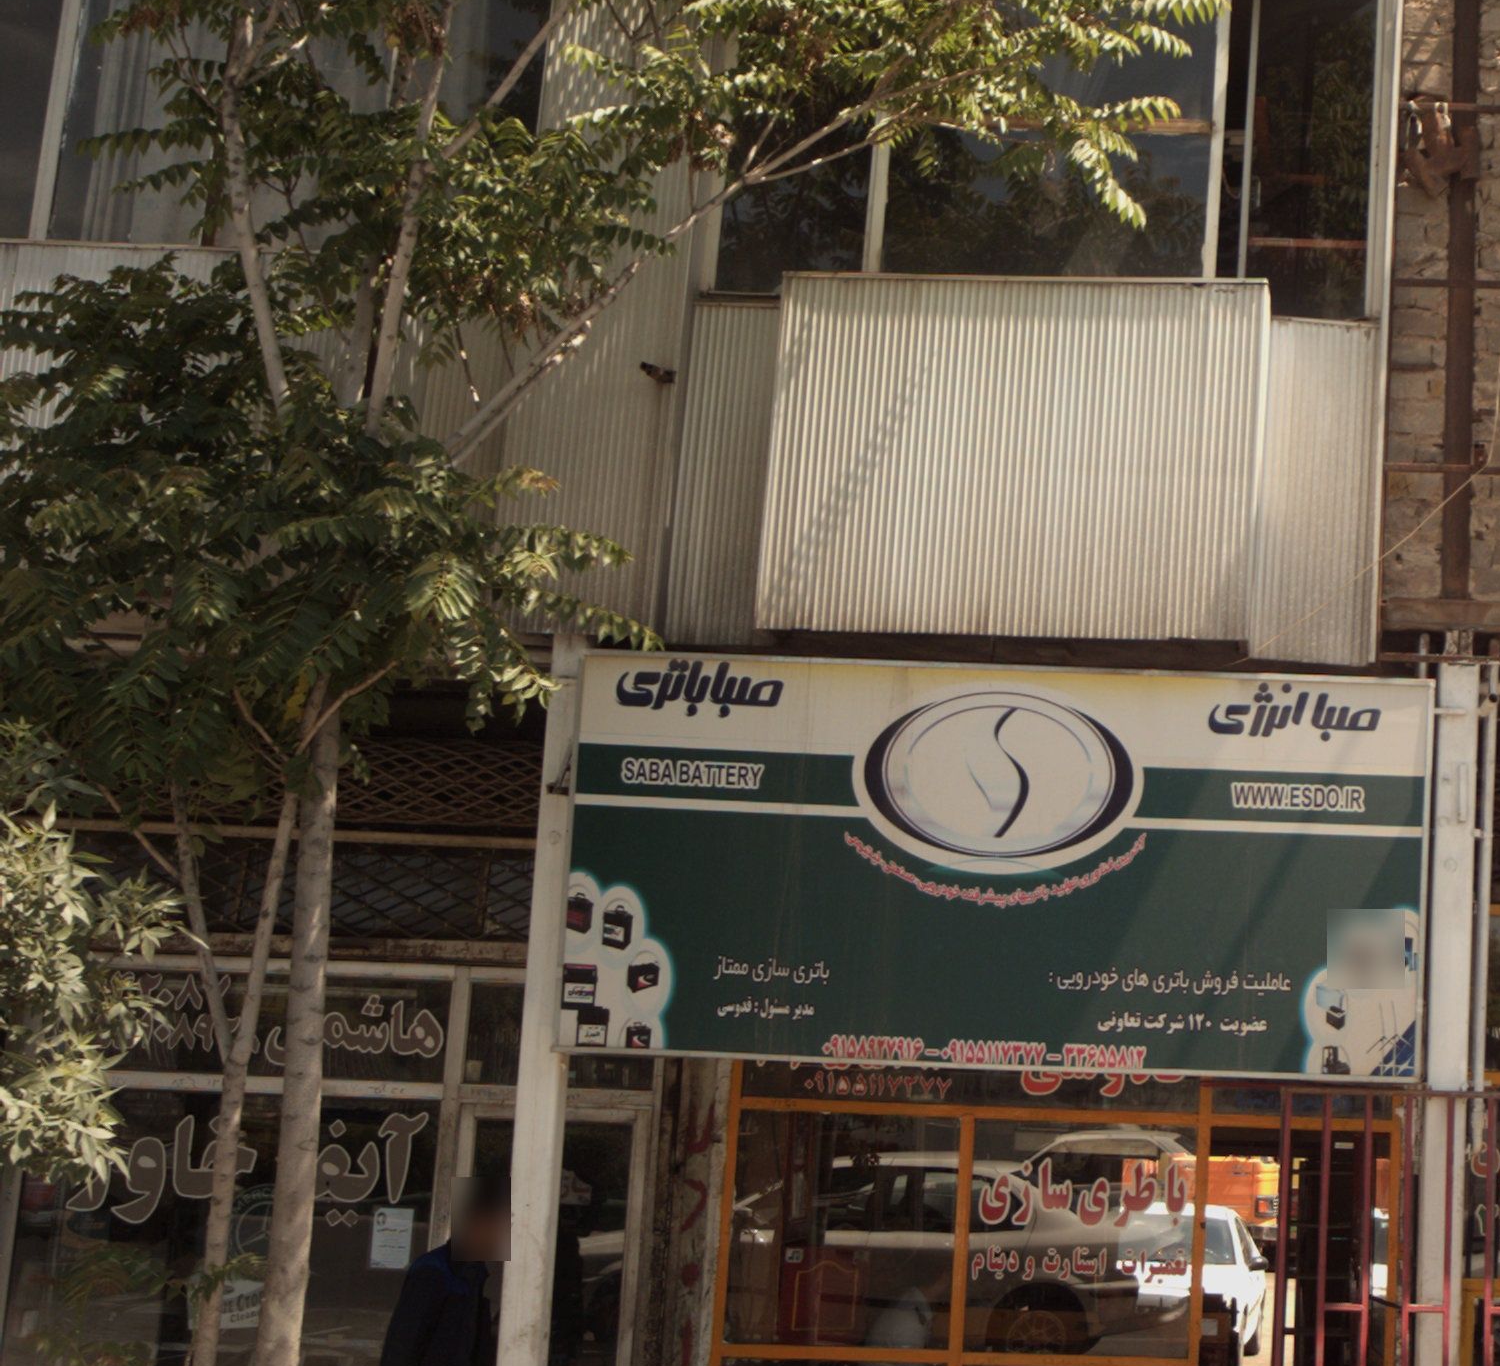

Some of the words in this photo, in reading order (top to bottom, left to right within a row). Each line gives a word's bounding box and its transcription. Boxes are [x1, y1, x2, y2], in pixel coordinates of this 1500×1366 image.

[1208, 682, 1310, 738] انرژی
[1310, 691, 1382, 742] صبا
[621, 757, 675, 784] SABA
[677, 759, 765, 789] BATTERY
[1231, 782, 1365, 812] WWW.ESDO.IR
[713, 955, 749, 980] ممتاز
[752, 957, 790, 983] سازی
[793, 960, 830, 985] باتری
[1121, 968, 1149, 992] های
[1152, 969, 1190, 995] باتری
[1193, 970, 1239, 995] فروش
[1243, 970, 1292, 997] عاملیت
[717, 996, 752, 1017] قدوسی
[1096, 1009, 1141, 1033] تعاونی
[1143, 1011, 1185, 1034] شرکت
[1219, 1013, 1268, 1036] عضویت
[979, 1156, 1073, 1226] سازی
[1077, 1161, 1188, 1227] باطری
[971, 1244, 1020, 1282] دینام
[1022, 1254, 1036, 1282] و
[1042, 1244, 1107, 1282] استارت
